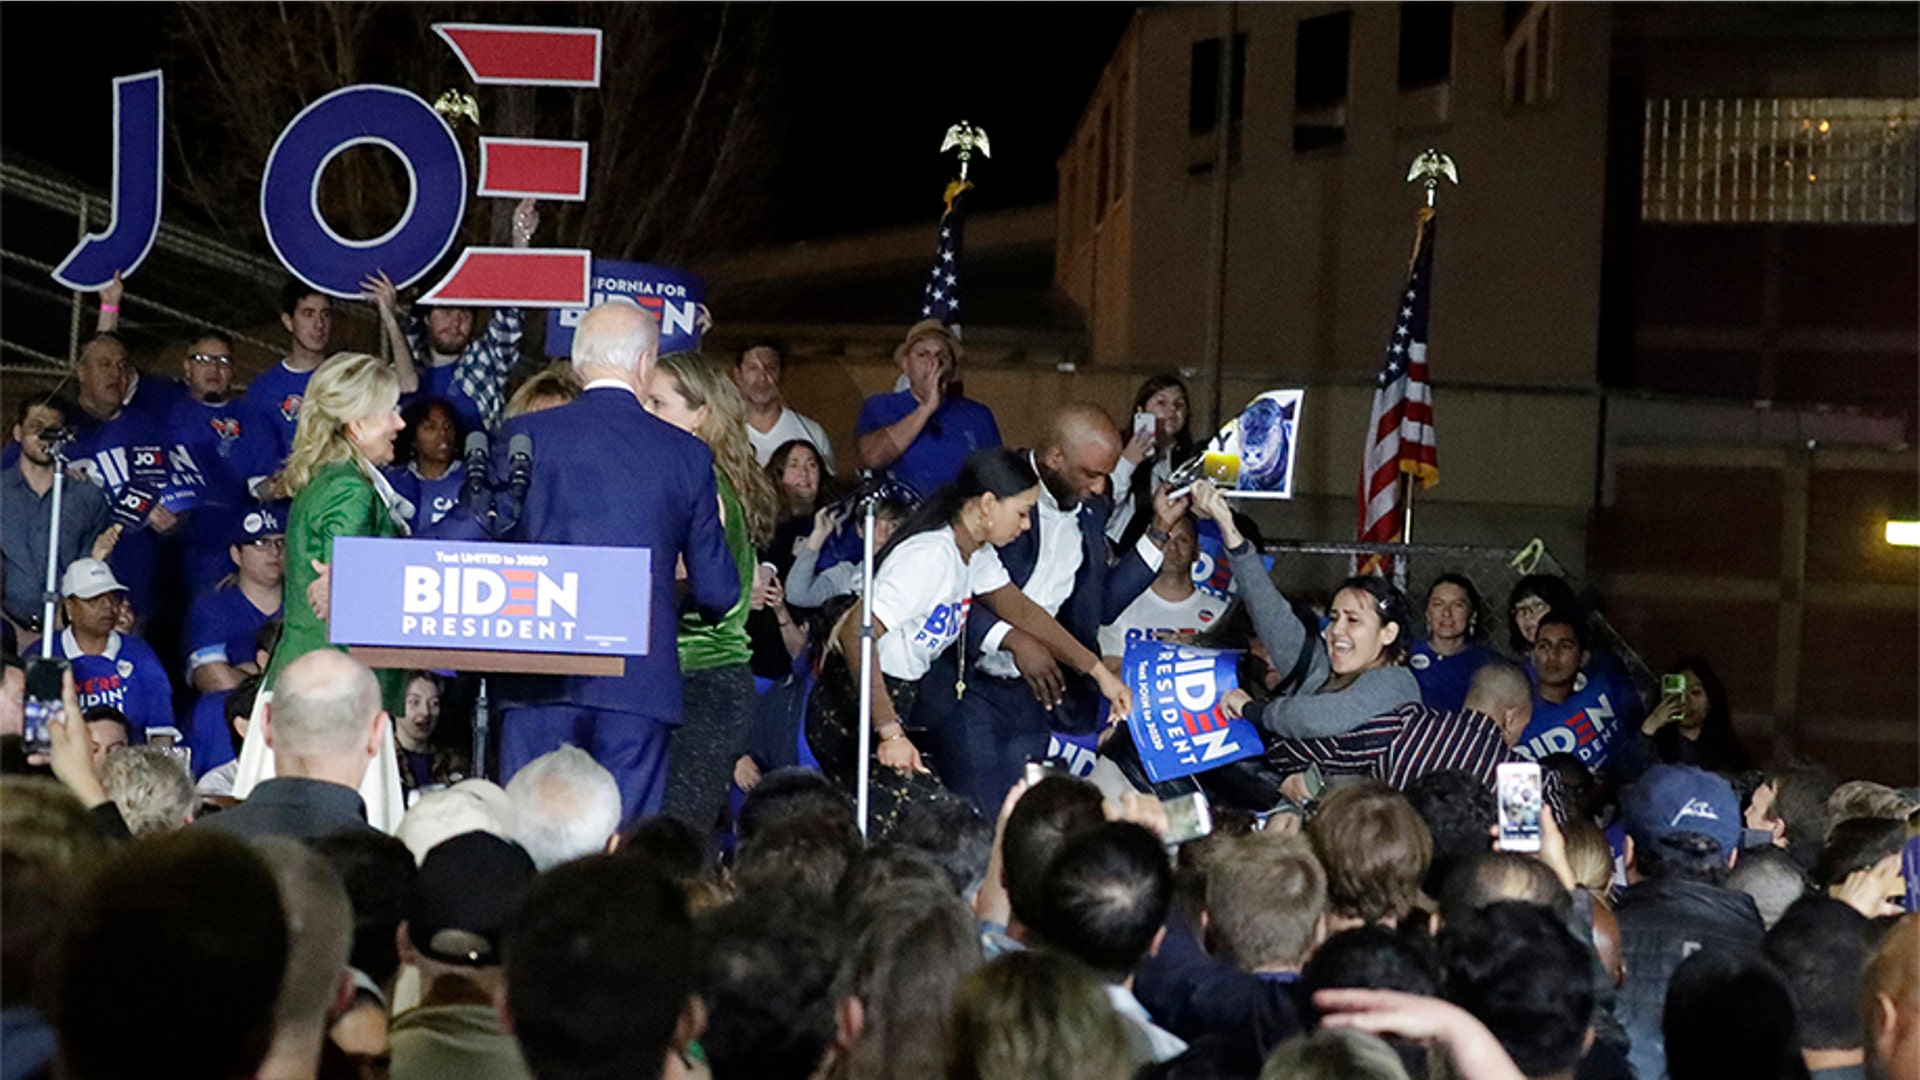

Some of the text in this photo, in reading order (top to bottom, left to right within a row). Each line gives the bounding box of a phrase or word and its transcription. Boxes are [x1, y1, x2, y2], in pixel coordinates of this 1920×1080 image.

[52, 22, 603, 309] JOE
[592, 277, 697, 298] IFORNIA FOR
[133, 452, 163, 467] JOE
[119, 494, 148, 513] JOE
[435, 551, 460, 563] Text
[461, 553, 502, 565] UNITED
[503, 554, 516, 566] to
[403, 565, 578, 620] BIDEN
[402, 615, 576, 641] PRESIDENT
[1138, 660, 1149, 681] Text
[79, 685, 128, 707] IDIN'
